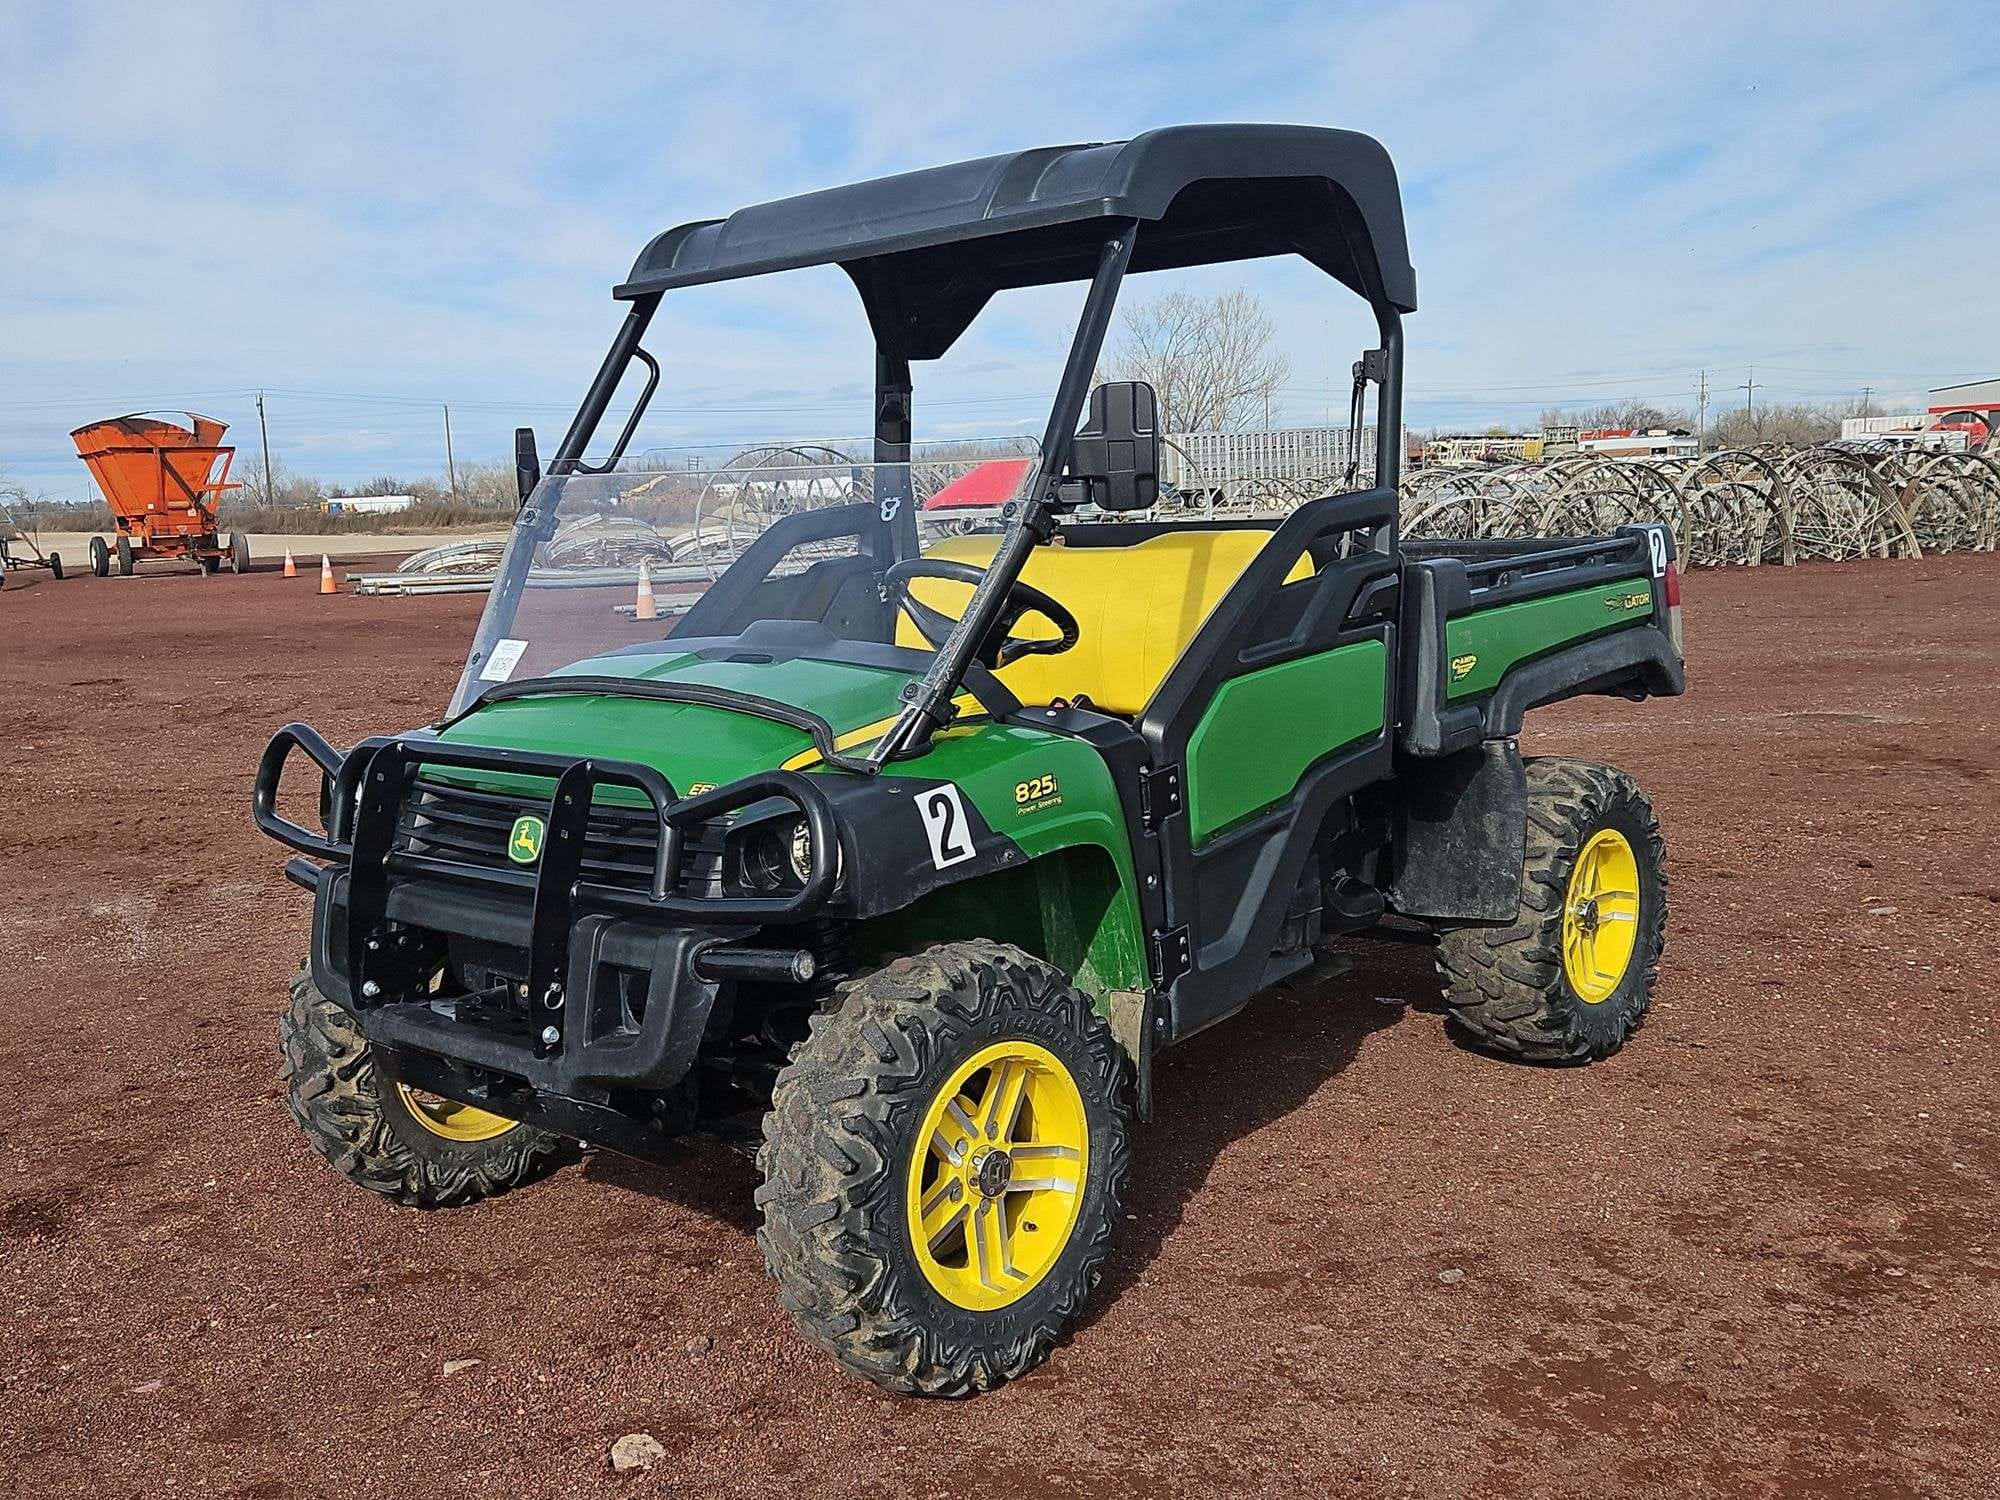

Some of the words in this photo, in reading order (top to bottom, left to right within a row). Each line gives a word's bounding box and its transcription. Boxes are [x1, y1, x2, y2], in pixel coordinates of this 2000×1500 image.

[1652, 532, 1665, 574] 2
[1624, 592, 1650, 609] GATOR
[1015, 774, 1058, 804] 825i
[1017, 804, 1037, 816] Power
[1037, 796, 1062, 809] Steering
[928, 793, 966, 862] 2
[986, 1015, 1083, 1061] BIGHORN
